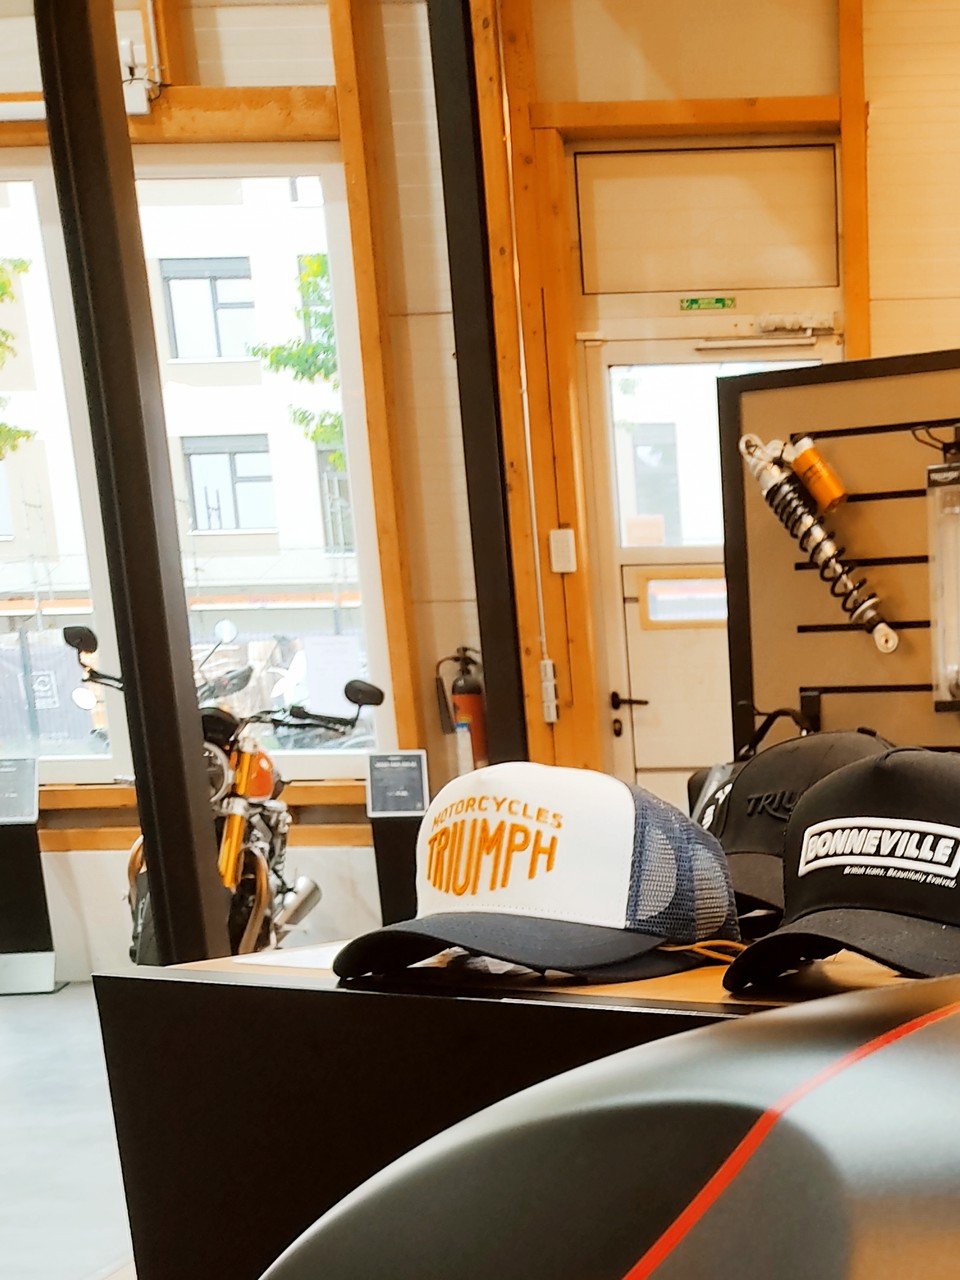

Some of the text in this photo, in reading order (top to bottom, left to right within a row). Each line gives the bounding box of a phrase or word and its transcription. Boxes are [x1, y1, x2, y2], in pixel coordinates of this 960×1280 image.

[432, 796, 563, 831] MOTORCYCLES
[427, 818, 558, 896] TRIUMPH
[805, 829, 955, 864] BONNEVILLE
